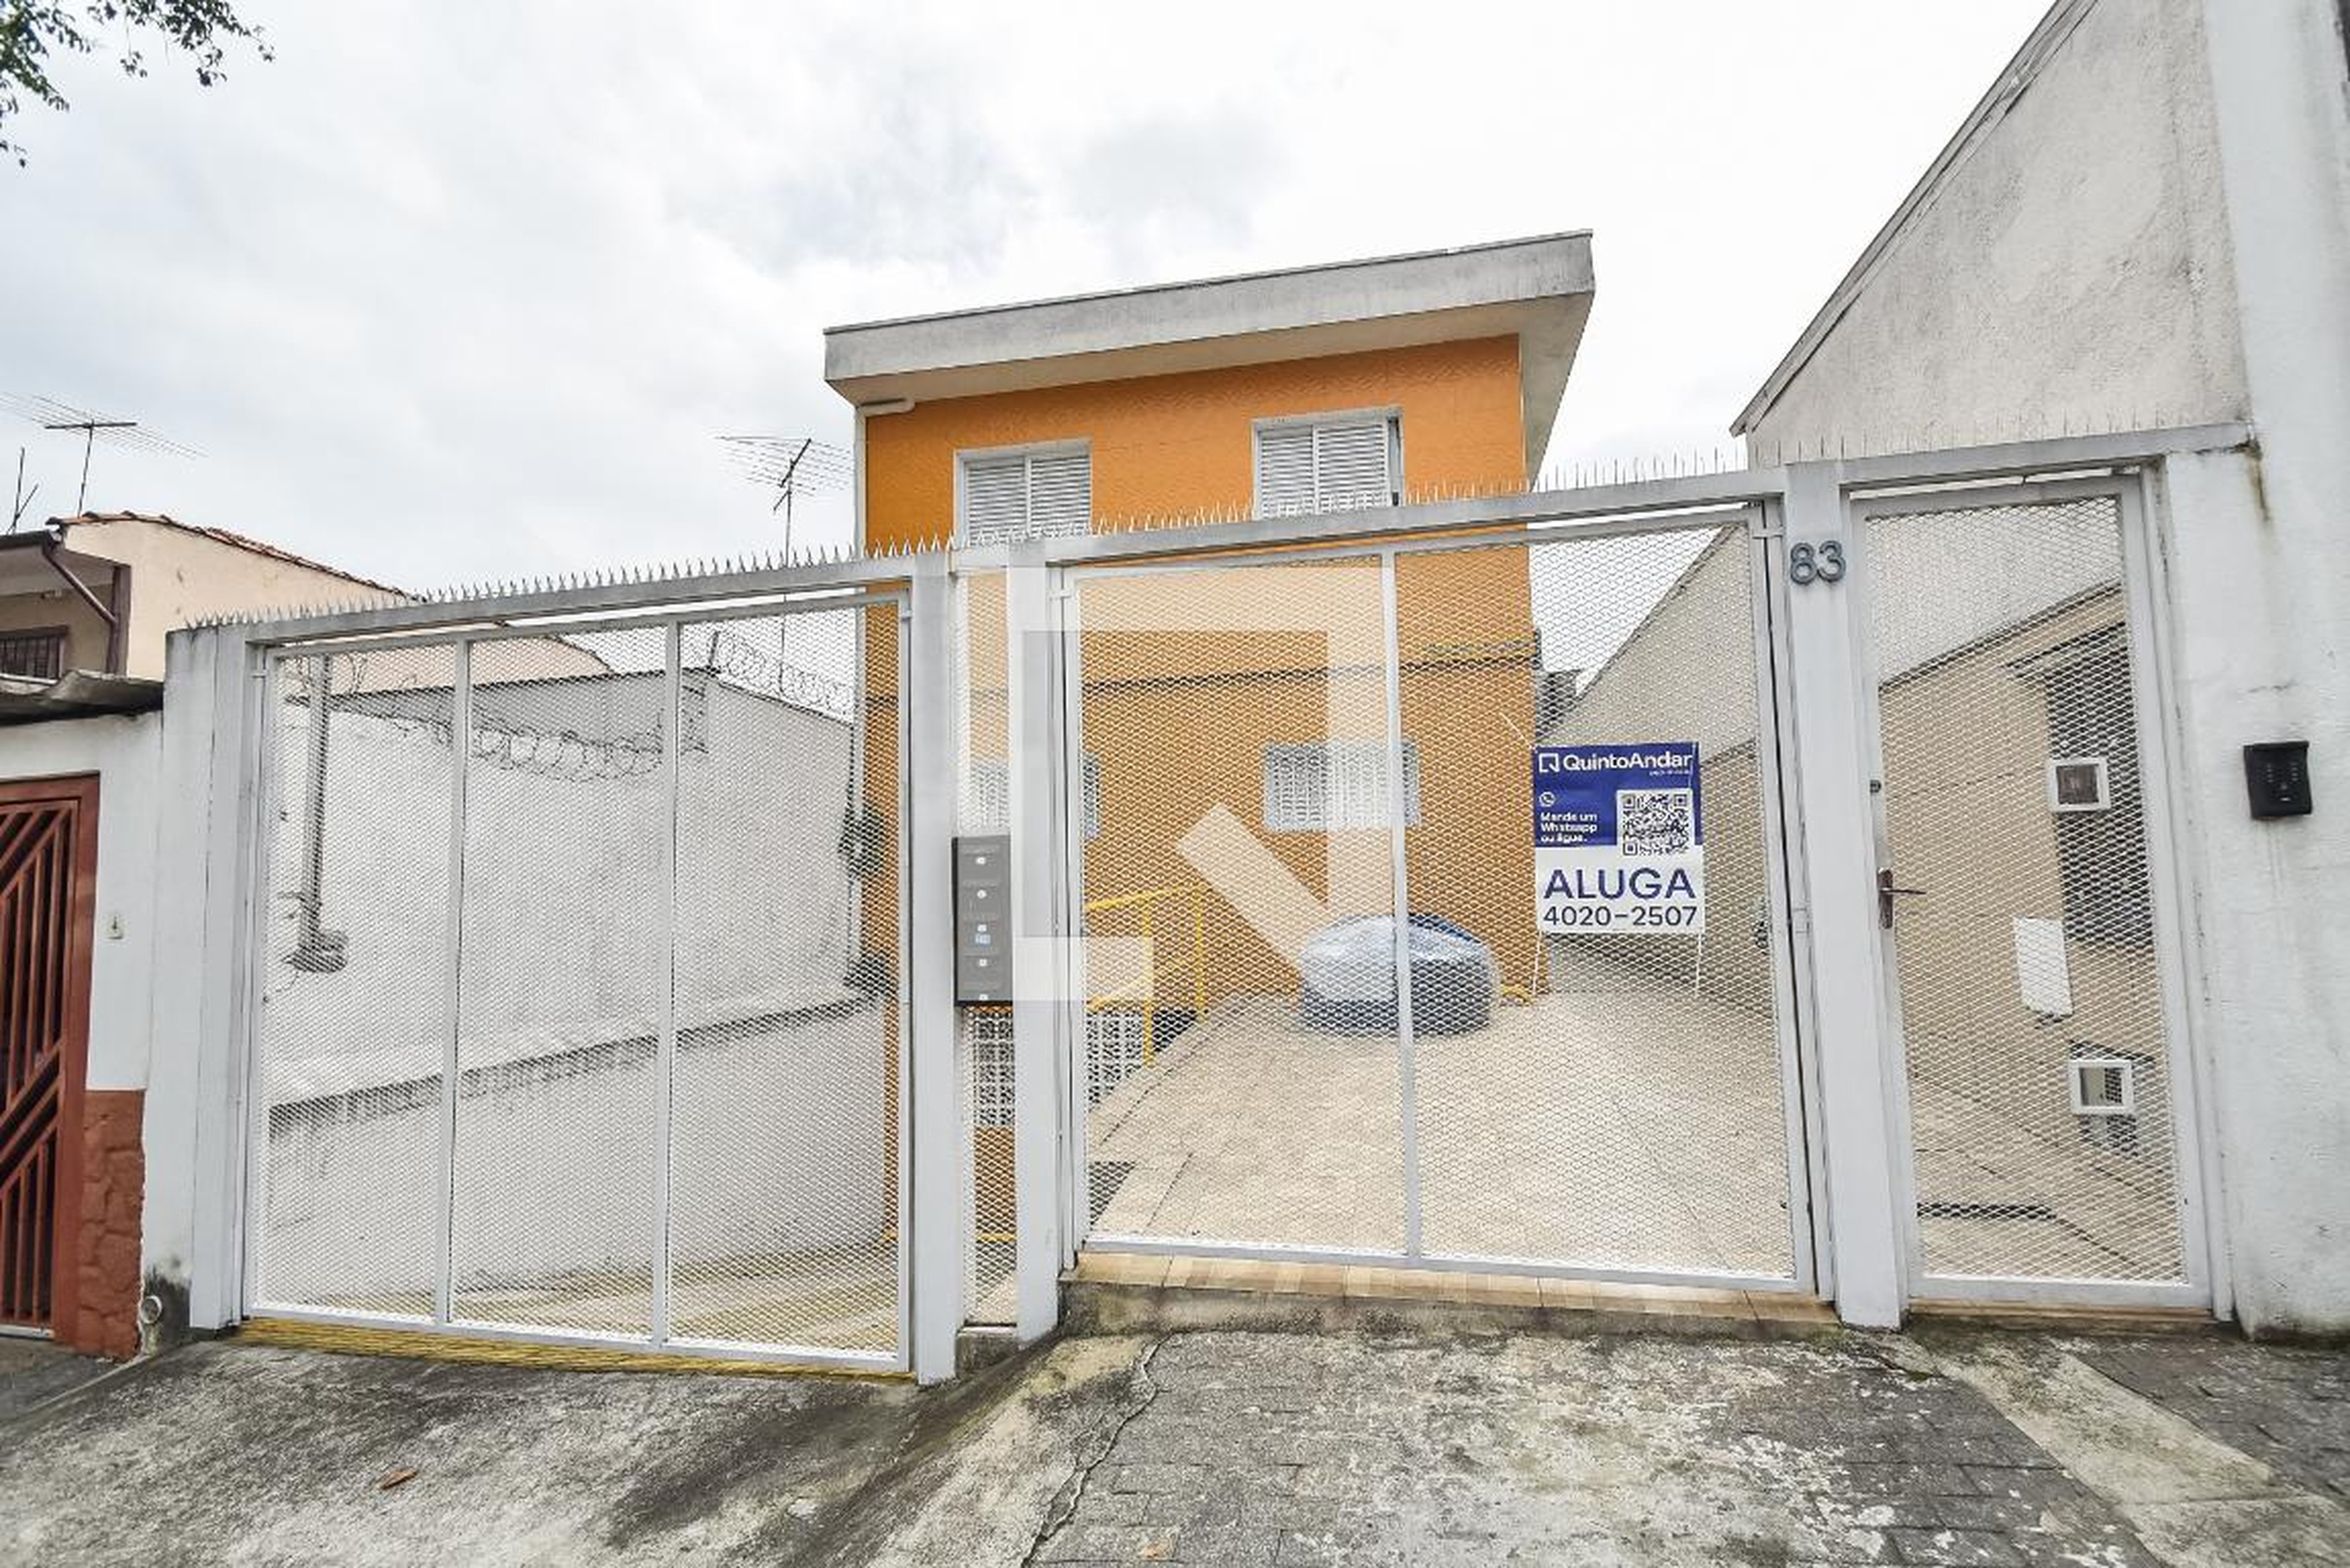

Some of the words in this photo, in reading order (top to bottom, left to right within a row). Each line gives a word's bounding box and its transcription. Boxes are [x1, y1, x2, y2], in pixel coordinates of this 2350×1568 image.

[1790, 540, 1846, 585] 83
[1563, 751, 1693, 772] QuintoAndar
[1543, 867, 1696, 900] ALUGA
[1543, 906, 1697, 926] 4020-2507
